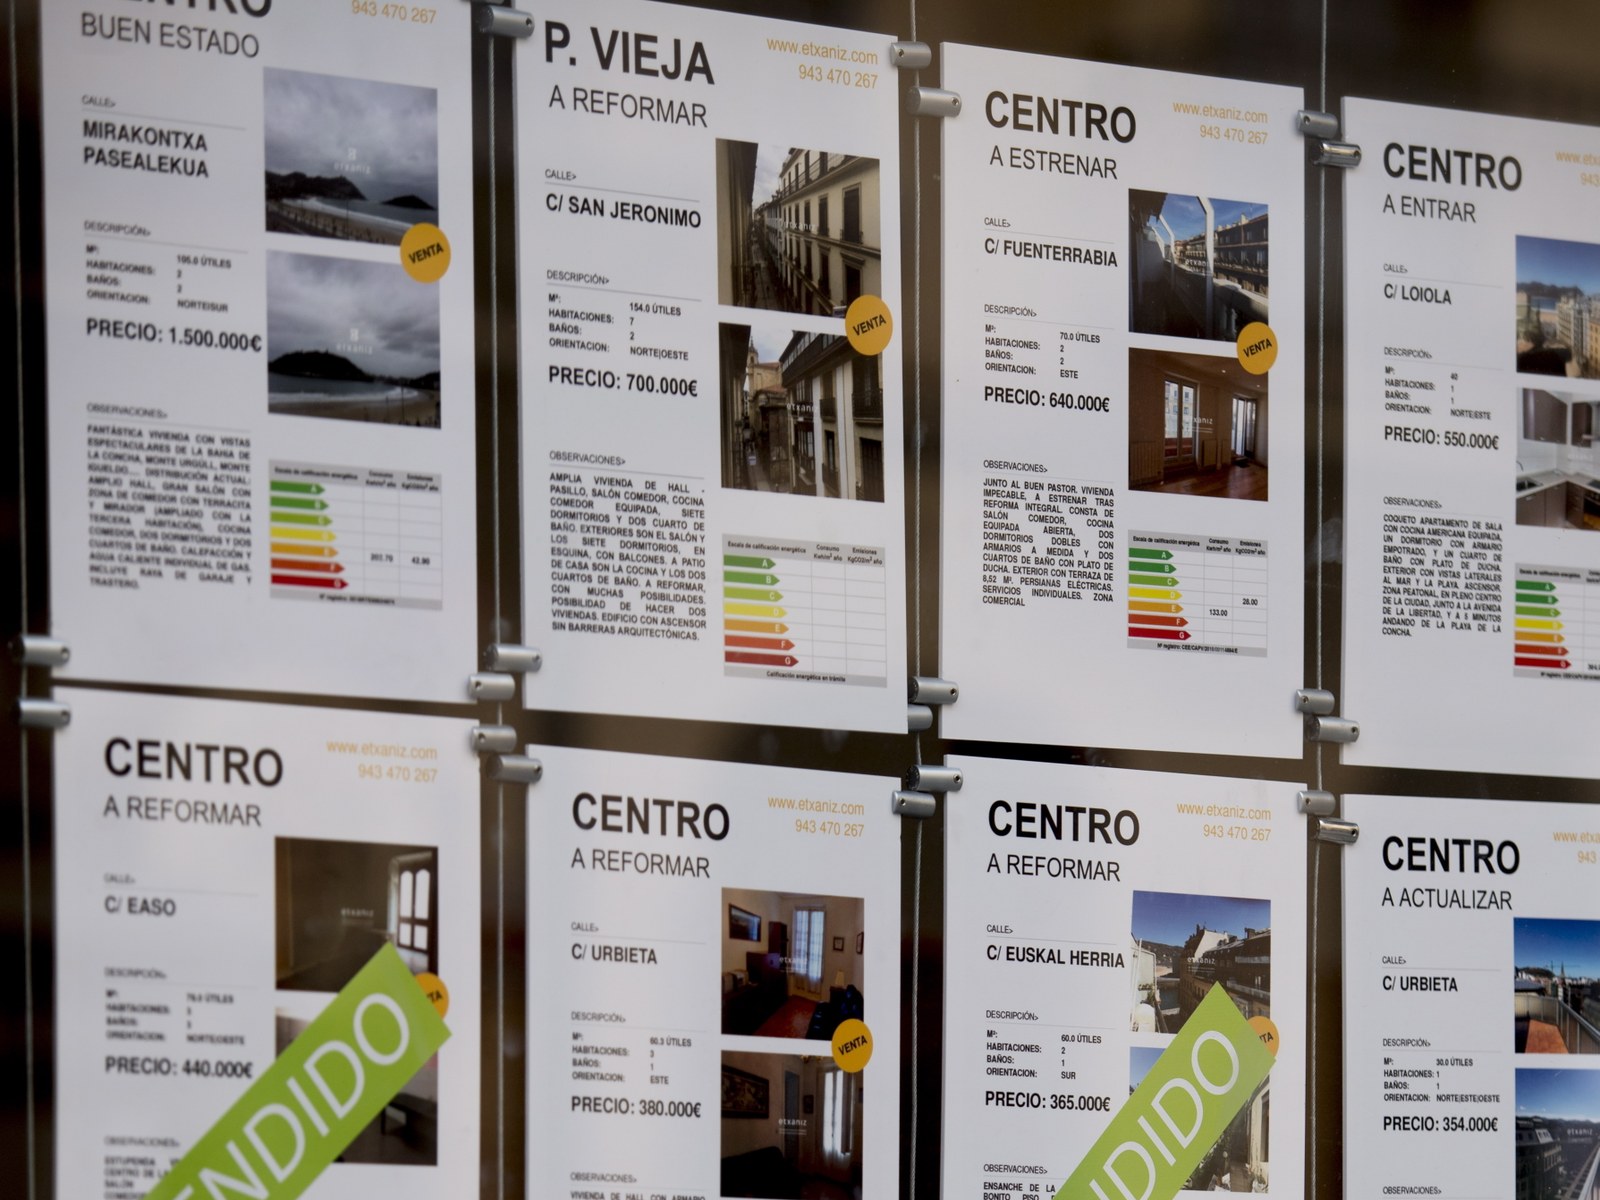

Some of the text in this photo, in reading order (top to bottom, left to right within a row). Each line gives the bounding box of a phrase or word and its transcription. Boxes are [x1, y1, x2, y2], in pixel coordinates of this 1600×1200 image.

[81, 11, 260, 59] BUEN ESTADO
[544, 20, 715, 85] P. VIEJA
[766, 38, 878, 65] www.etxaniz.com
[798, 63, 879, 89] 943 470 267
[548, 84, 708, 128] A REFORMAR
[985, 90, 1137, 144] CENTRO
[1172, 102, 1268, 123] www.etxaniz.com
[82, 119, 208, 155] MIRAKONTXA
[1199, 124, 1268, 145] 943 470 267
[83, 145, 209, 178] PASEALEKUA
[989, 144, 1118, 180] A ESTRENAR
[1383, 142, 1523, 192] CENTRO
[545, 192, 702, 229] C/ SAN JERONIMO
[1382, 193, 1477, 223] A ENTRAR
[406, 241, 445, 265] VENTA
[984, 237, 1118, 268] C/ FUENTERRABIA
[1383, 282, 1452, 305] C/ LOIOLA
[86, 317, 262, 353] PRECIO: 1.500.000€
[851, 313, 887, 338] VENTA
[984, 336, 1041, 350] HABITACIONES:
[1242, 337, 1274, 359] VENTA
[548, 365, 698, 398] PRECIO: 700.000€
[984, 385, 1110, 413] PRECIO: 640.000€
[1384, 425, 1500, 451] PRECIO: 550.000€
[983, 477, 1115, 497] JUNTO AL BUEN PASTOR. VIVIENDA
[551, 621, 698, 641] SIN BARRERAS ARQUITECTÓNICAS.
[104, 736, 284, 788] CENTRO
[103, 795, 262, 827] A REFORMAR
[572, 792, 730, 842] CENTRO
[767, 797, 865, 816] www.etxaniz.com
[1176, 803, 1272, 821] www.etxaniz.com
[988, 799, 1140, 846] CENTRO
[570, 847, 711, 879] A REFORMAR
[986, 852, 1121, 882] A REFORMAR
[1382, 835, 1520, 875] CENTRO
[103, 894, 177, 917] C/ EASO
[1381, 886, 1513, 911] A ACTUALIZAR
[571, 942, 658, 965] C/ URBIETA
[986, 944, 1125, 969] C/ EUSKAL HERRIA
[1382, 975, 1458, 992] C/ URBIETA
[837, 1034, 868, 1057] VENTA
[104, 1055, 253, 1079] PRECIO: 440.000€
[571, 1095, 702, 1119] PRECIO: 380.000€
[985, 1090, 1111, 1112] PRECIO: 365.000€
[1383, 1115, 1499, 1132] PRECIO: 354.000€
